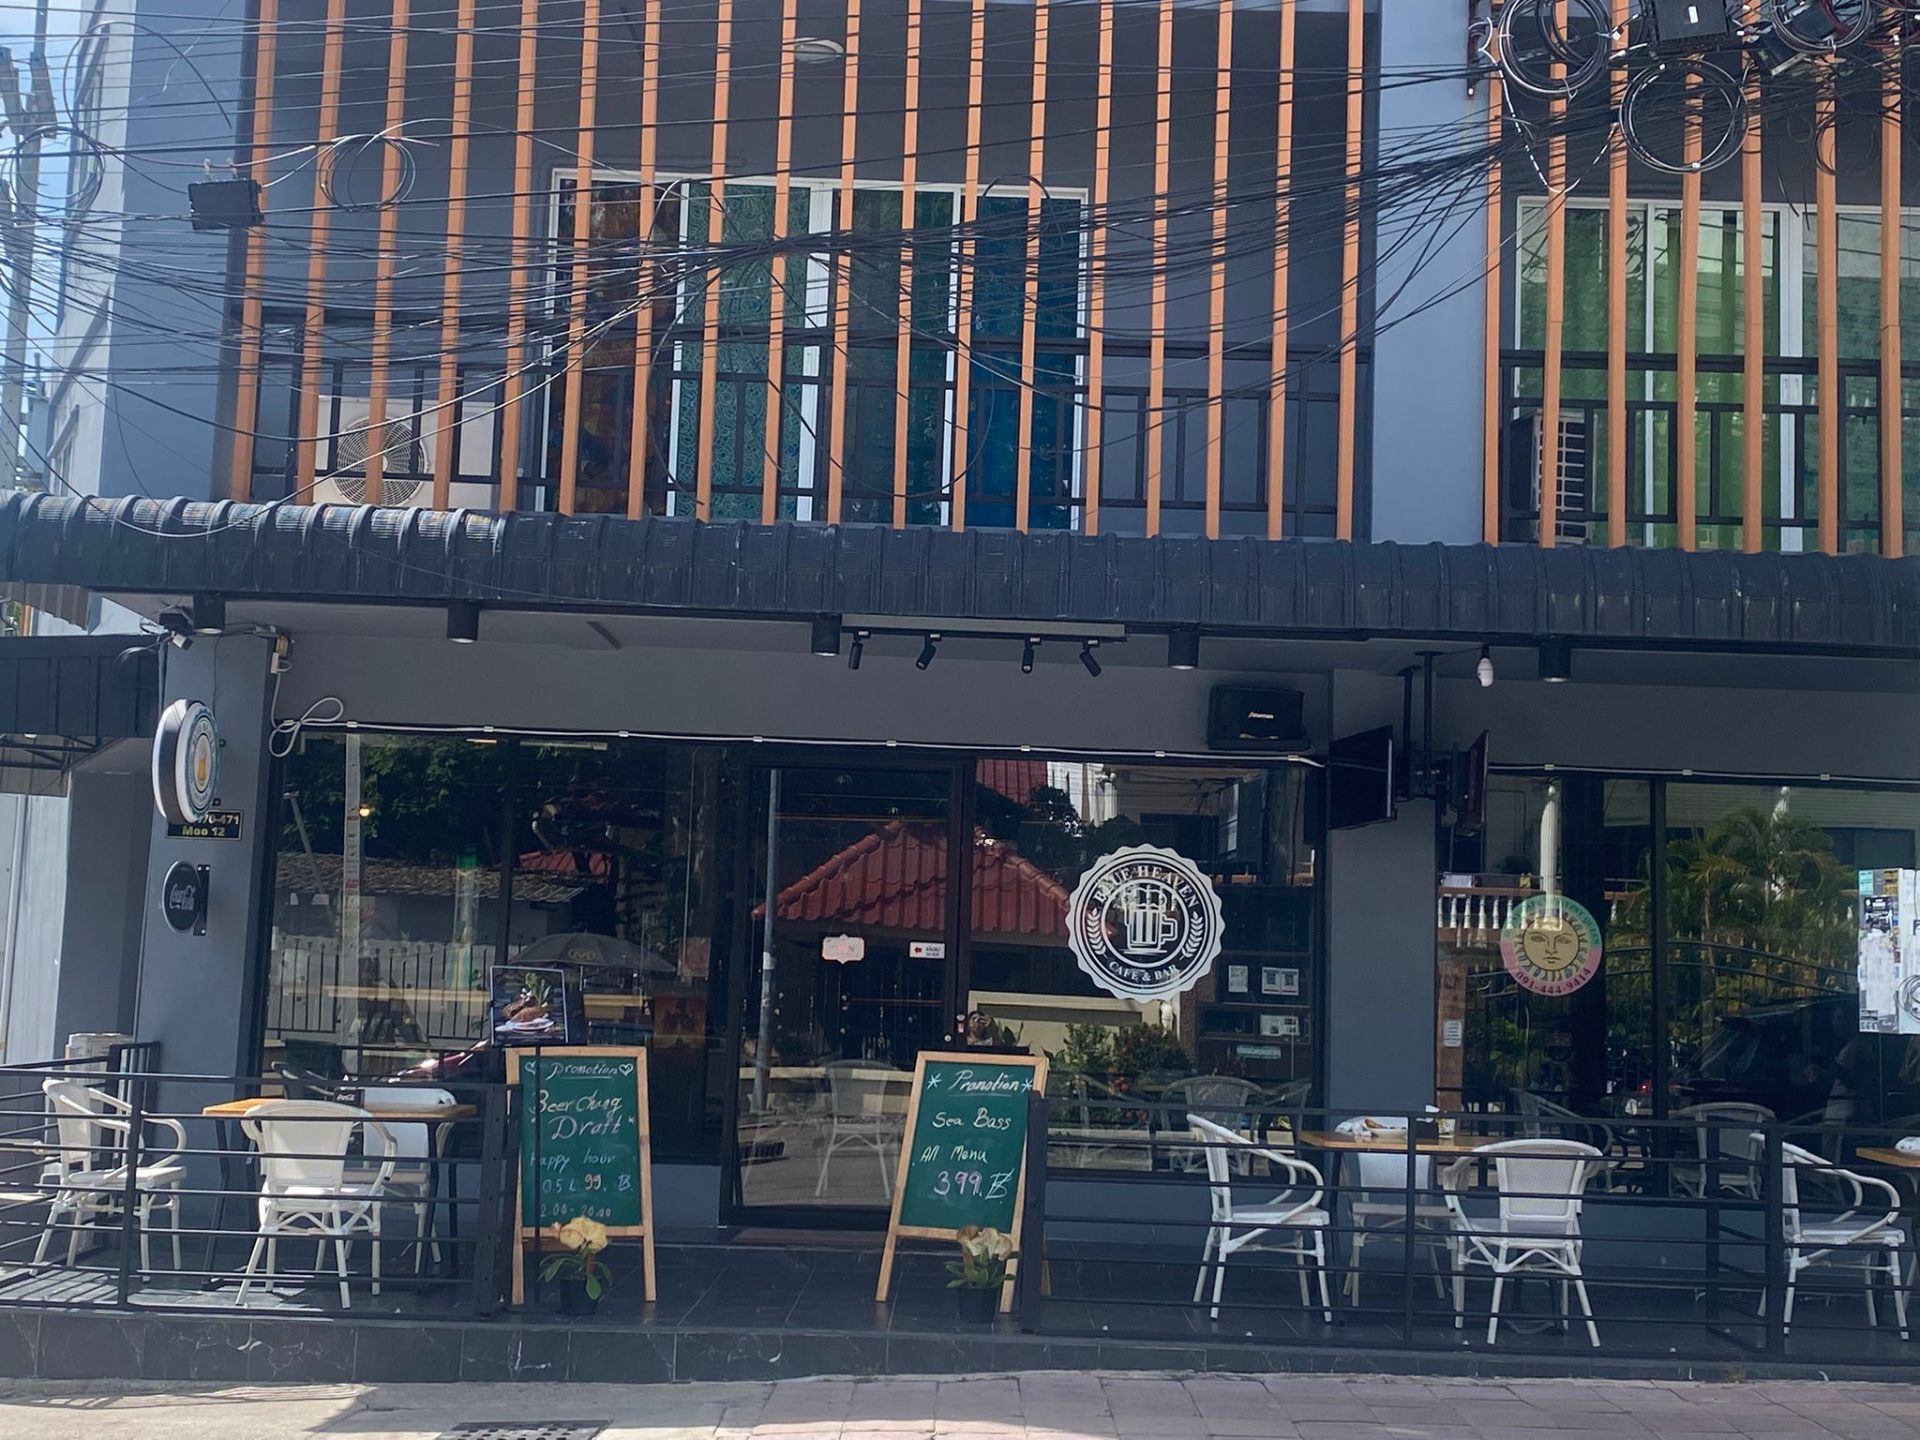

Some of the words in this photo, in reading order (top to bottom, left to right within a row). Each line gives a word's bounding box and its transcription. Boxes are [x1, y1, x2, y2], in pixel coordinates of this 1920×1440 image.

[182, 825, 209, 836] Moo
[211, 827, 225, 837] 12
[1094, 869, 1134, 904] BLUE
[1137, 865, 1200, 909] HEAVEN
[1108, 960, 1140, 982] CAFE
[1141, 972, 1152, 982] &
[1154, 963, 1181, 981] BAR
[947, 1069, 1020, 1092] Promotion
[529, 1089, 575, 1114] Beer
[548, 1114, 623, 1140] Draft
[932, 1111, 964, 1128] Sea
[973, 1106, 1012, 1131] Bass
[583, 1147, 617, 1165] hour
[920, 1145, 939, 1162] All
[950, 1145, 988, 1164] Menu
